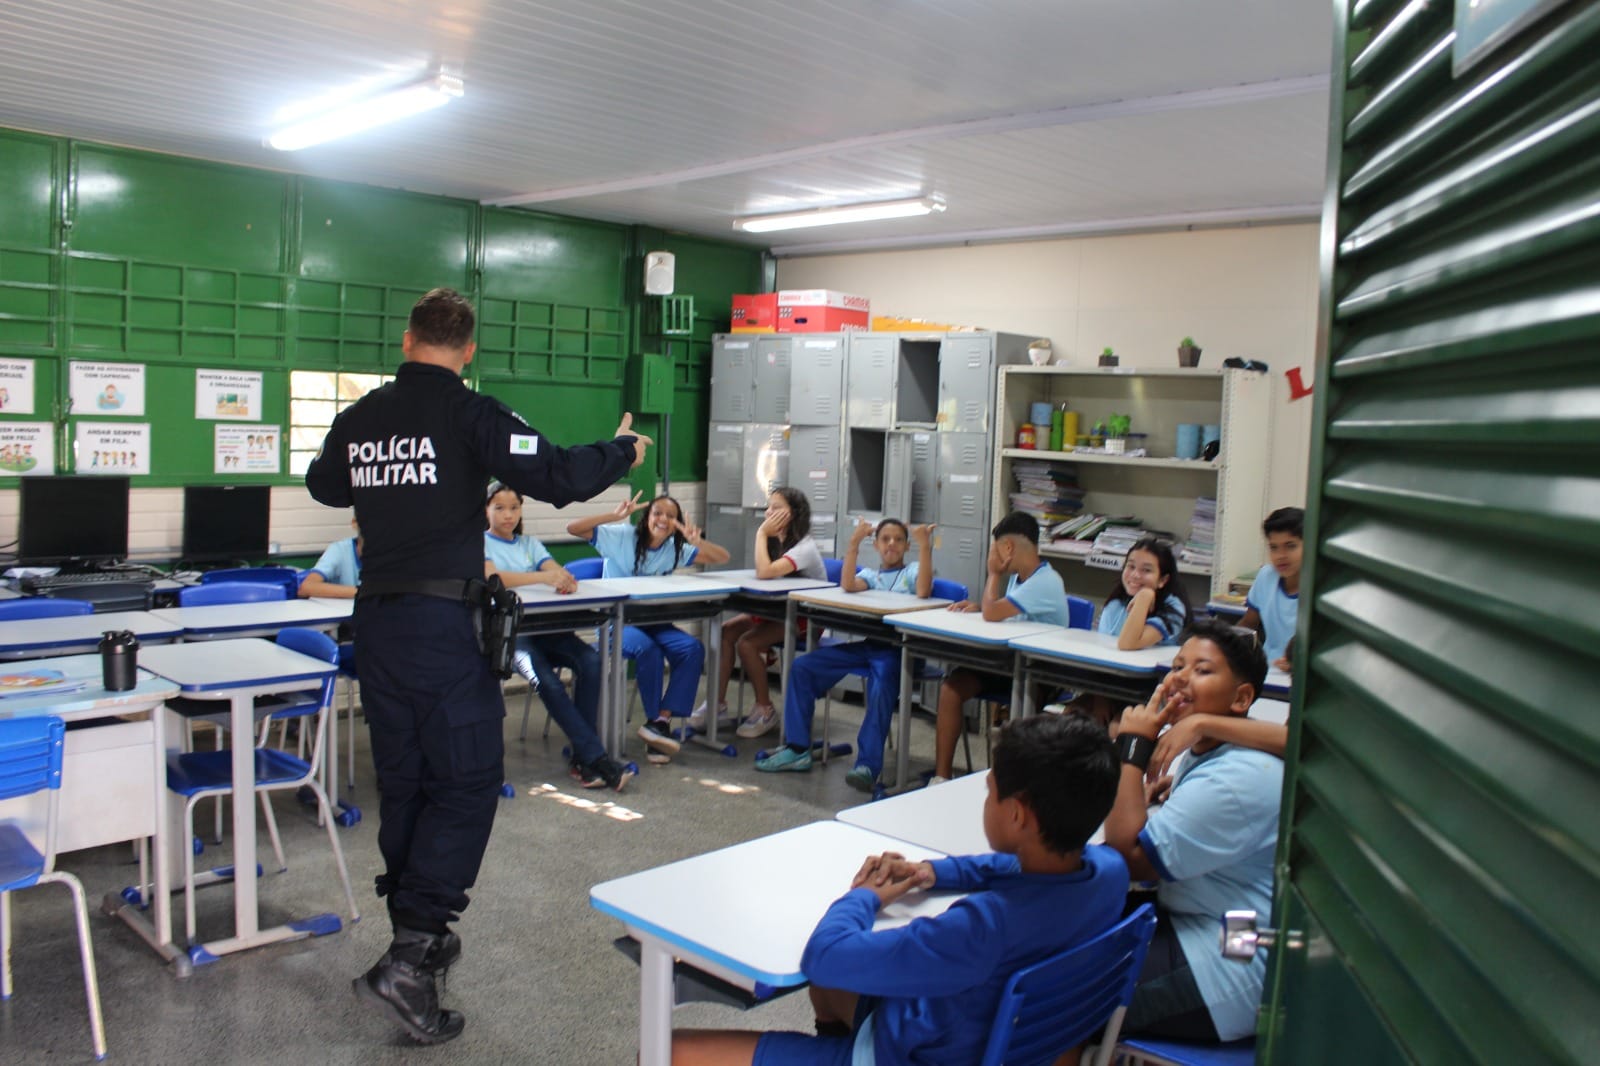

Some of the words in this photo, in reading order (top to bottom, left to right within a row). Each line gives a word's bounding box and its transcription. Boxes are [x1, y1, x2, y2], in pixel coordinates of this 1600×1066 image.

[113, 429, 142, 437] SEMPRE
[348, 436, 436, 464] POLÍCIA
[350, 462, 437, 488] MILITAR
